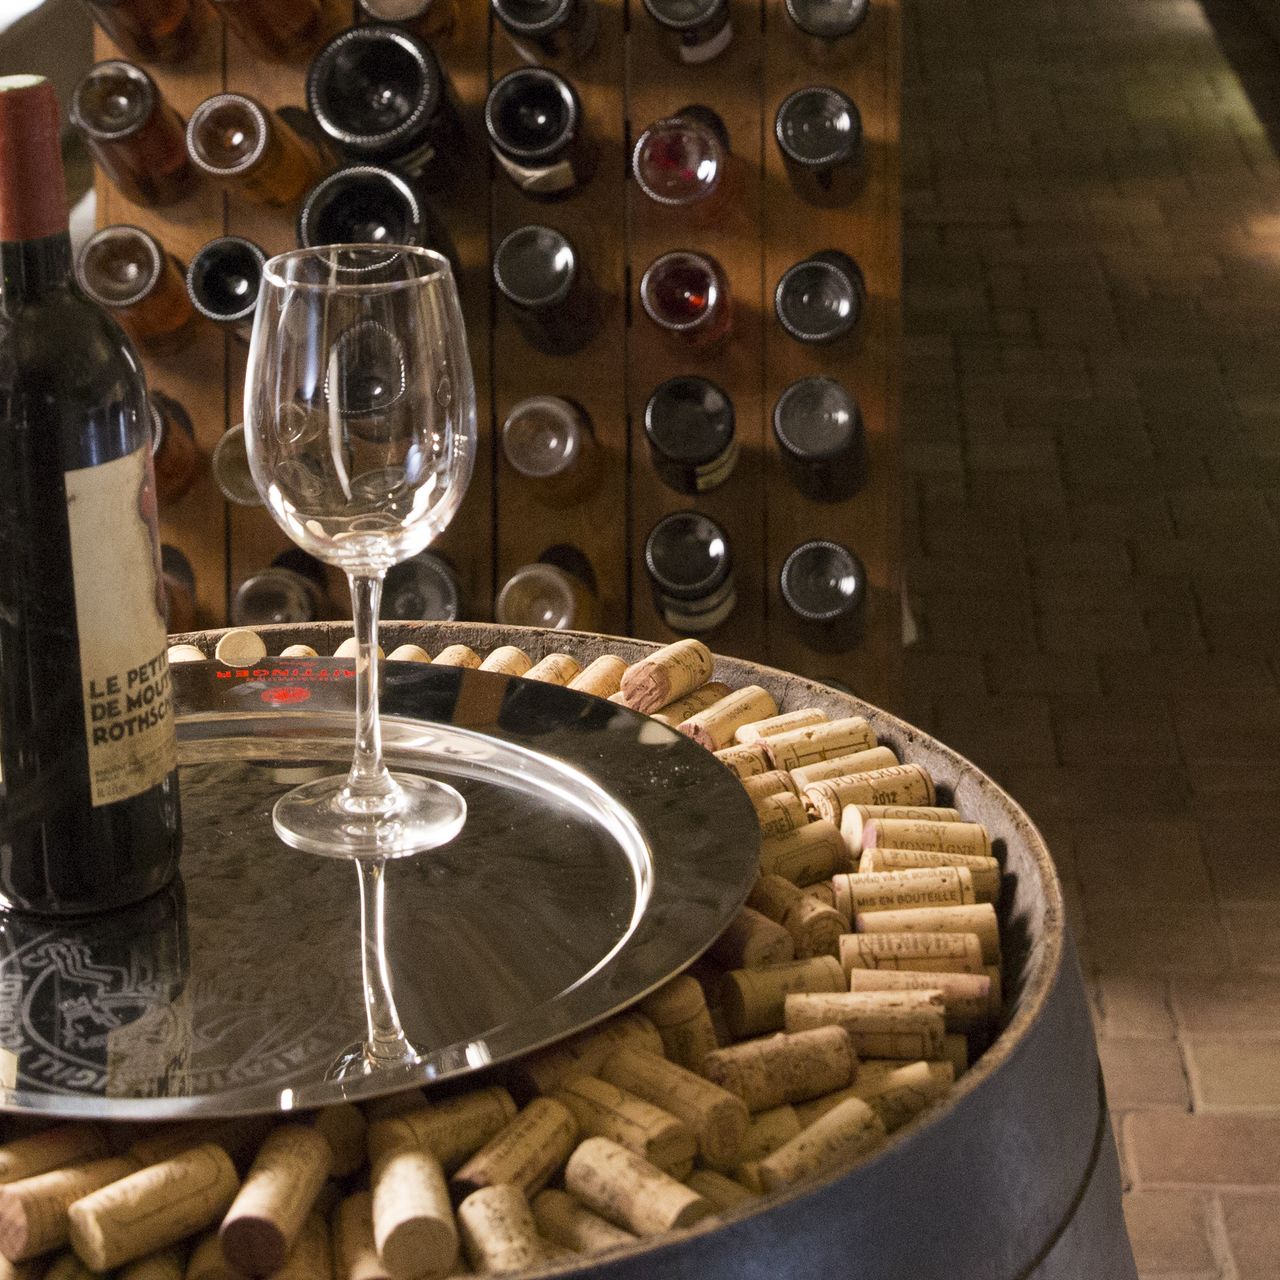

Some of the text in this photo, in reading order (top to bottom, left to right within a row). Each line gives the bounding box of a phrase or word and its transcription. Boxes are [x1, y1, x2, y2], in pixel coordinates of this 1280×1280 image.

[90, 675, 121, 699] LE
[91, 698, 121, 722] DE
[872, 791, 898, 806] 2012
[856, 890, 959, 907] MIS EN BOUTEILLE
